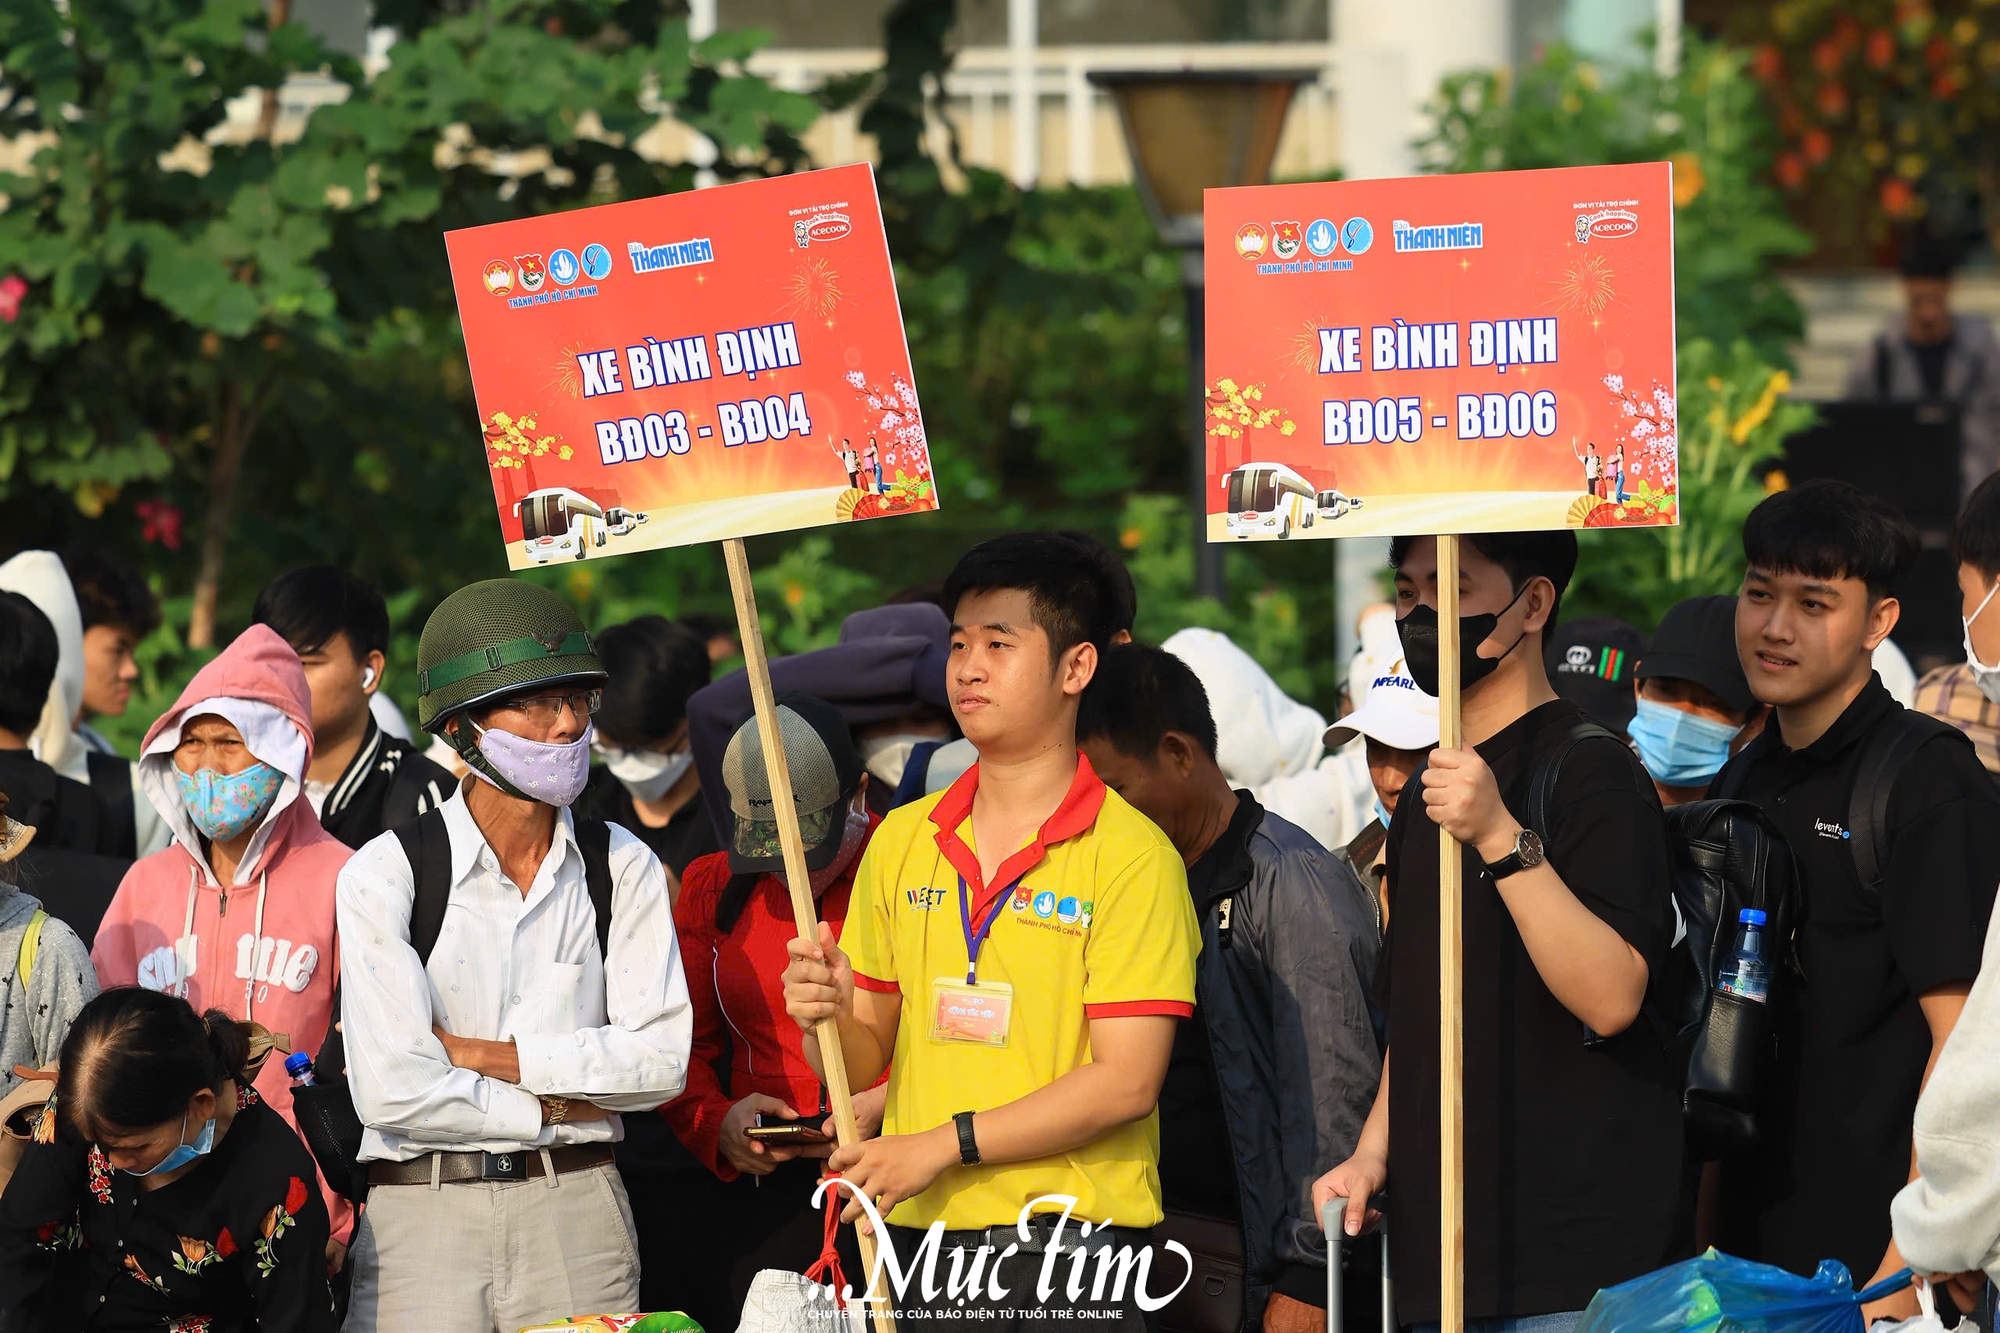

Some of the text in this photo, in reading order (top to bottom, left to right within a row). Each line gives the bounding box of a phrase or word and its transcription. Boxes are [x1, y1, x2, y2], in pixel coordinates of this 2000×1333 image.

[806, 212, 849, 226] Cook happiness
[1589, 209, 1637, 222] Cook happiness
[1394, 229, 1445, 251] THANH
[1447, 224, 1482, 248] NIÊN
[631, 239, 713, 272] THANH NIÊN
[1257, 261, 1283, 275] THÀNH
[1316, 259, 1331, 272] CHÍ
[1332, 259, 1353, 271] MINH
[508, 294, 534, 309] THÀNH
[563, 285, 577, 300] CHÍ
[578, 285, 598, 298] MINH
[577, 321, 802, 398] XE BÌNH ĐỊNH
[1318, 317, 1558, 374] XE BÌNH ĐỊNH
[595, 392, 813, 466] BĐ03 - BĐ04
[1323, 390, 1557, 446] BĐ05 - BĐ06
